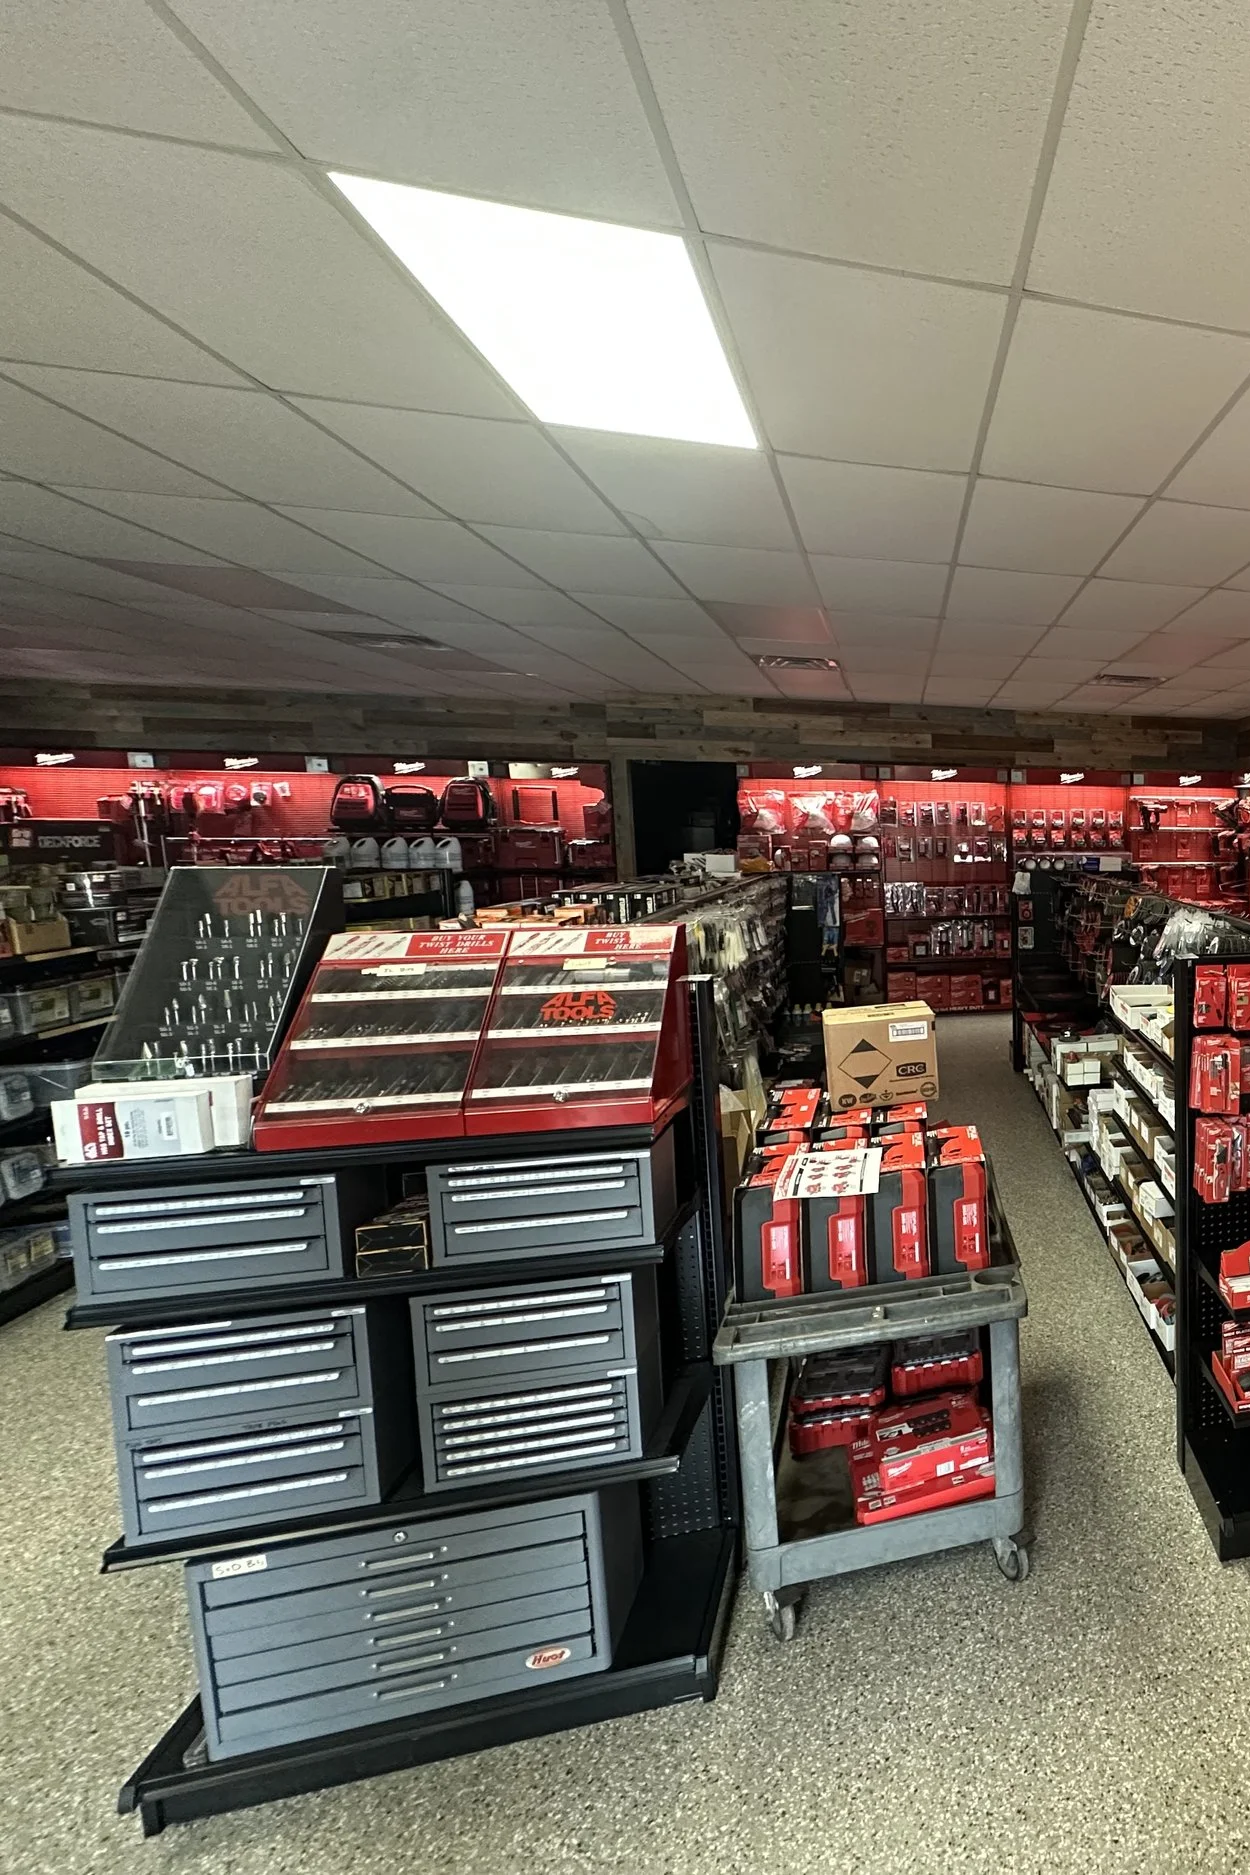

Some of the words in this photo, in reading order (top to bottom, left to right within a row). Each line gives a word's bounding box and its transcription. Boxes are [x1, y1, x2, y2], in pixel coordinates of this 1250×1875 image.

[216, 874, 309, 897] ALFA
[214, 895, 313, 917] TOOLS
[542, 991, 616, 1008] ALFA
[541, 1004, 615, 1021] TOOLS
[898, 1063, 924, 1075] CRC
[96, 1108, 104, 1124] DRILL
[104, 1116, 113, 1127] SET
[98, 1132, 107, 1142] TAP
[532, 1650, 566, 1666] Huot
